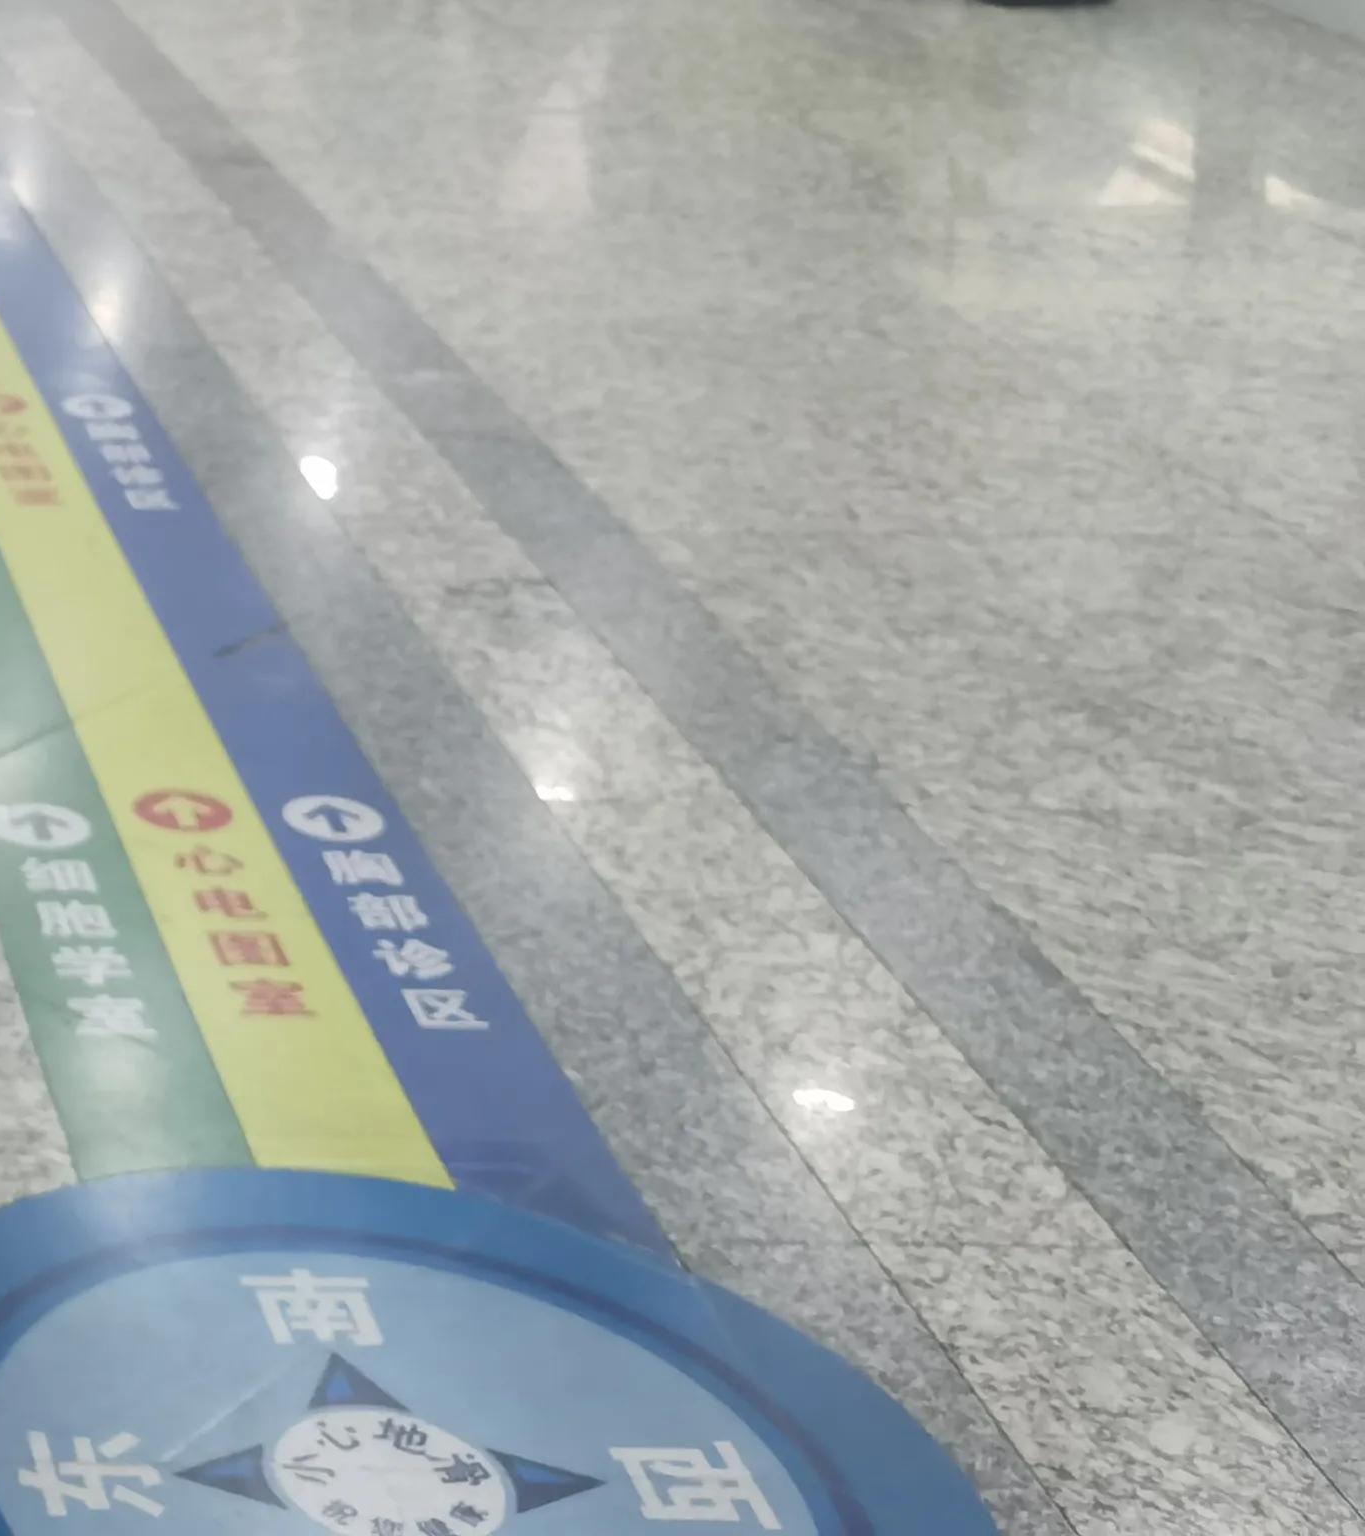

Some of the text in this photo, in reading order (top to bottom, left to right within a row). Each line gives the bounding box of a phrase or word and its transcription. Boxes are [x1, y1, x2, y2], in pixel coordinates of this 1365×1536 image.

[239, 1268, 385, 1346] 南
[18, 1430, 166, 1517] 东
[607, 1440, 782, 1530] 西
